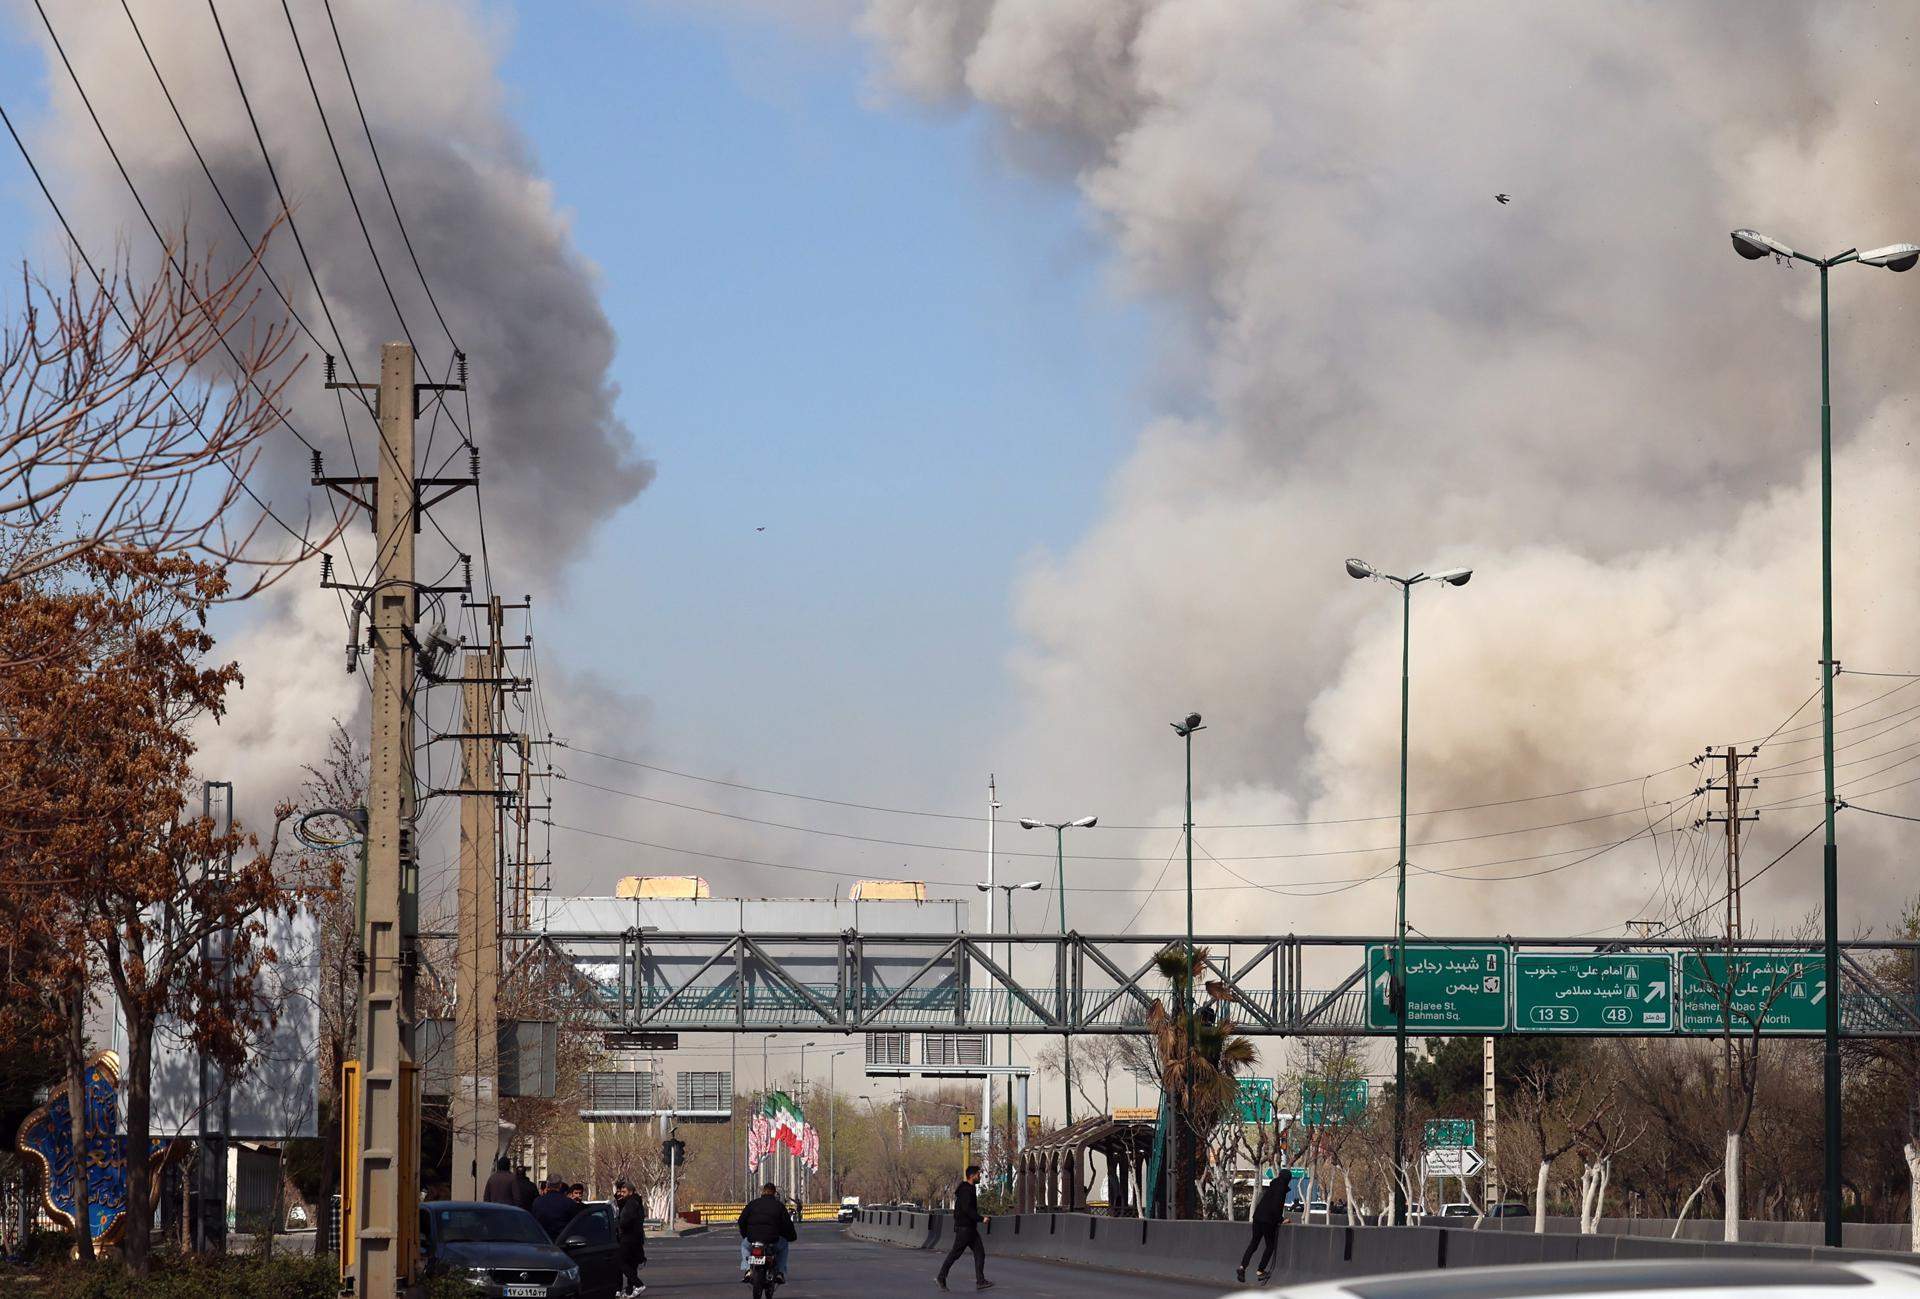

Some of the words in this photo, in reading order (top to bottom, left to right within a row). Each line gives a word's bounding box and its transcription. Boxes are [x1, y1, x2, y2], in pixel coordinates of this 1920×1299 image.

[1405, 959, 1442, 974] رجایی
[1445, 957, 1479, 973] شهید
[1525, 965, 1558, 979] جنوب
[1601, 966, 1623, 980] امام
[1445, 983, 1479, 995] بهمن
[1555, 986, 1592, 998] سلامی
[1593, 984, 1623, 998] شهید
[1408, 1002, 1442, 1011] Raja'ee
[1444, 1002, 1457, 1010] St.
[1685, 1002, 1722, 1010] Hashe
[1408, 1012, 1444, 1020] Bahman
[1446, 1012, 1461, 1021] Sq.
[1539, 1008, 1554, 1021] 13
[1560, 1008, 1569, 1021] S
[1607, 1008, 1626, 1021] 48
[1684, 1015, 1713, 1024] Imam
[1762, 1015, 1791, 1024] North
